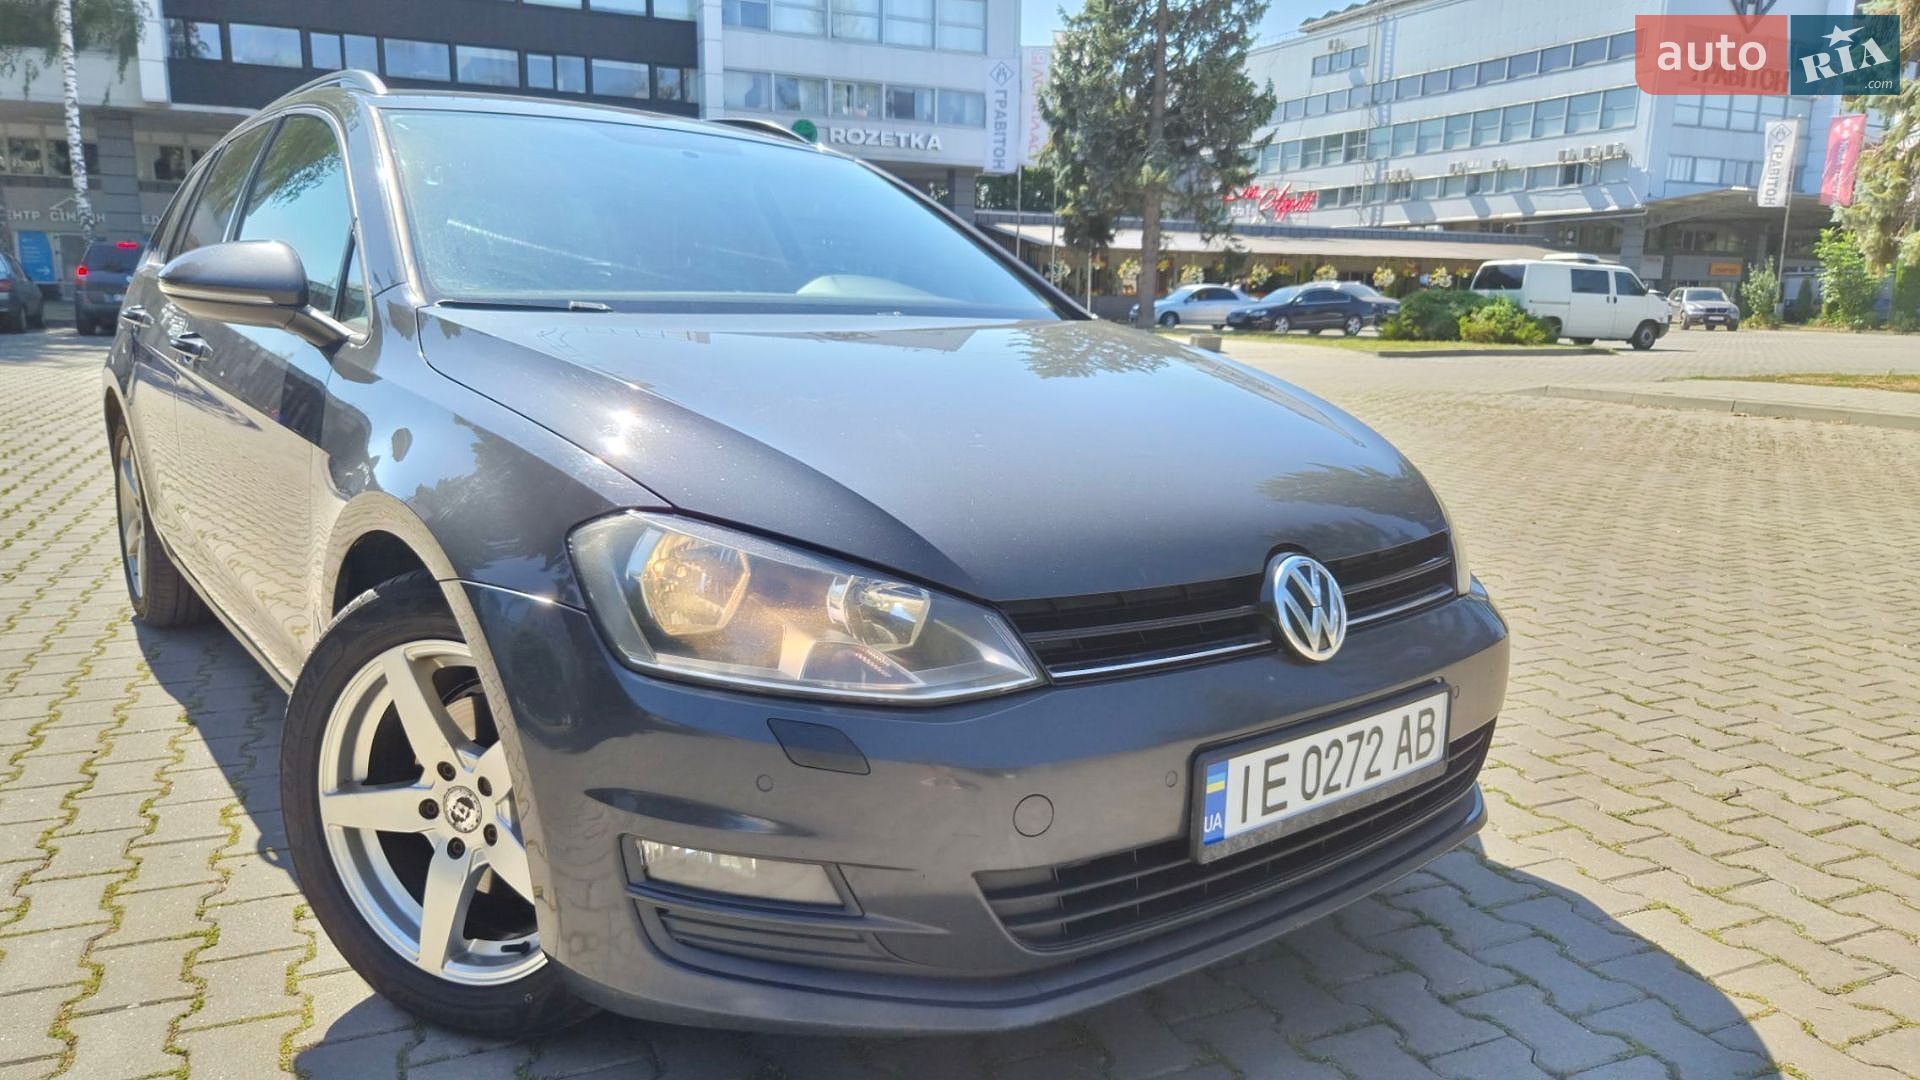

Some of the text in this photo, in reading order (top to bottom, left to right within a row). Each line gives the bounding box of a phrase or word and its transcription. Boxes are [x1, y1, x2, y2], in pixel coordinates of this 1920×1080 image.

[829, 126, 943, 151] ROZETKA
[993, 89, 1009, 169] ГРАВІТОН
[1763, 143, 1785, 205] ГРАВІТОН
[1240, 707, 1436, 824] IE 0272 AB
[1203, 812, 1223, 833] UA
